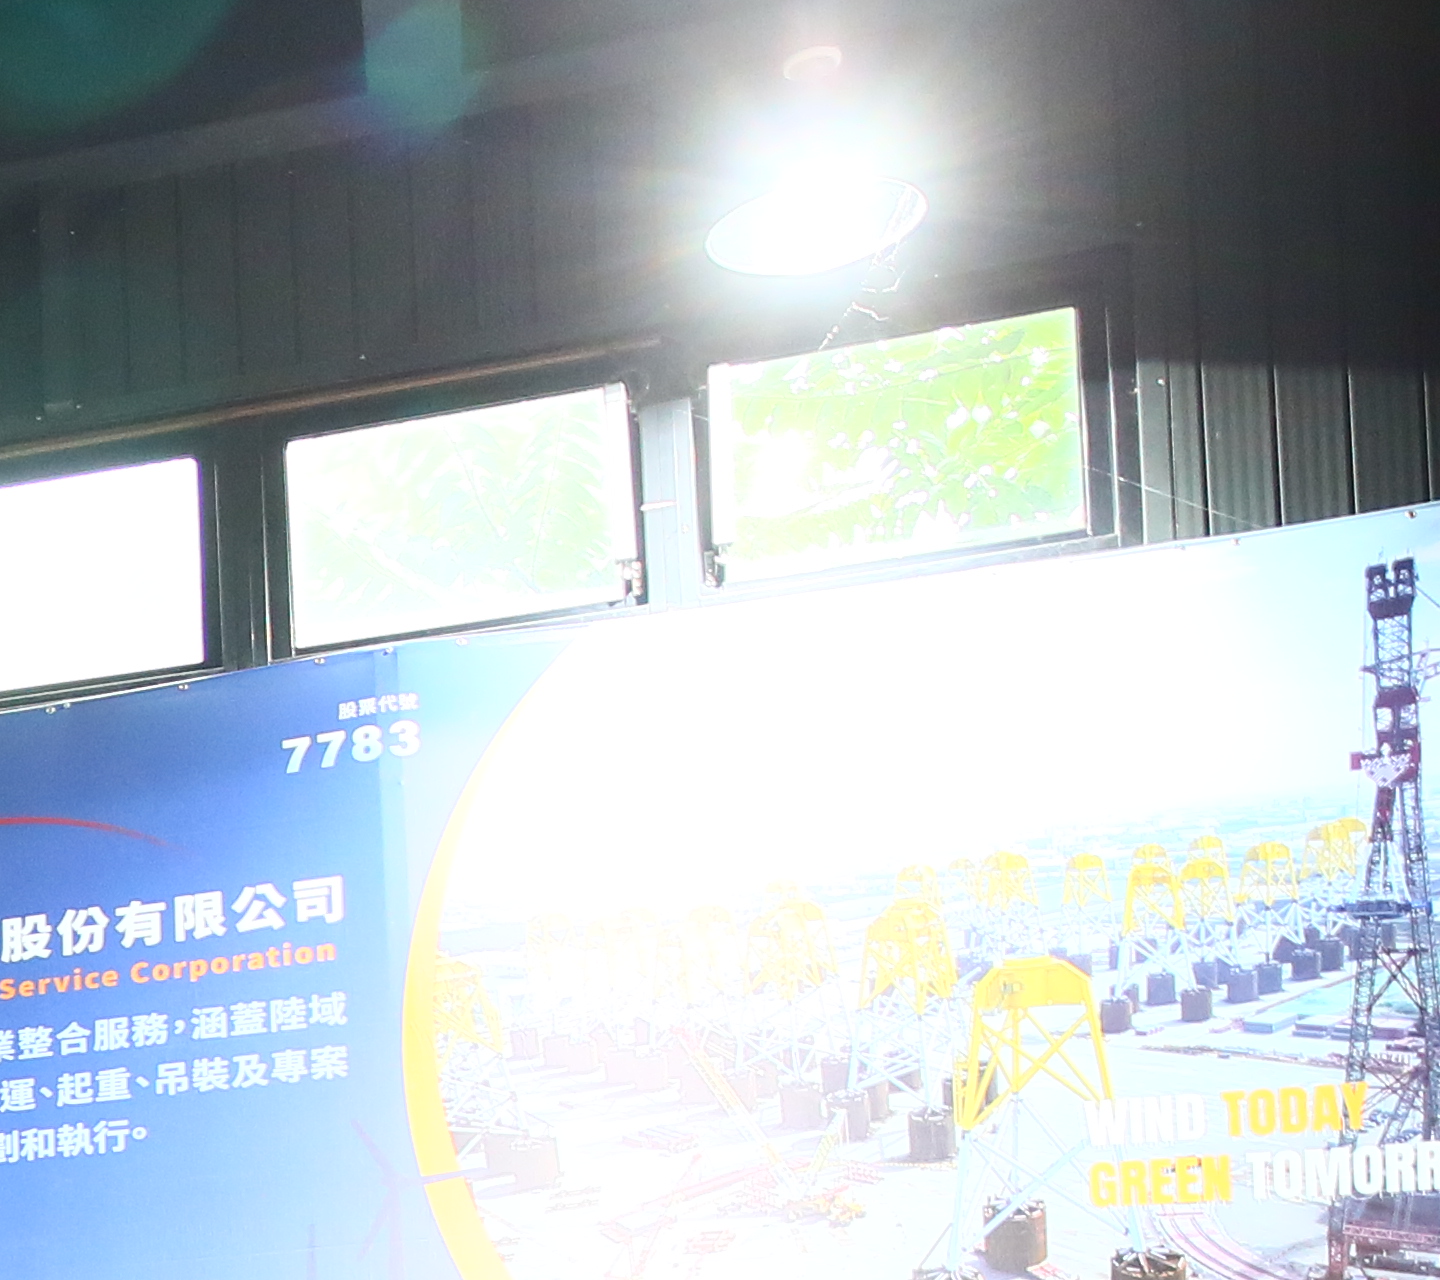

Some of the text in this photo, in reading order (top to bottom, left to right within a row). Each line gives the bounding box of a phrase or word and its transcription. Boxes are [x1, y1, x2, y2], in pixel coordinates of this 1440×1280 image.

[338, 693, 420, 720] 股票代號
[281, 719, 422, 774] 7783
[130, 941, 338, 983] Corporation
[1083, 1081, 1370, 1148] WIND TODAY
[1089, 1154, 1233, 1208] GREEN
